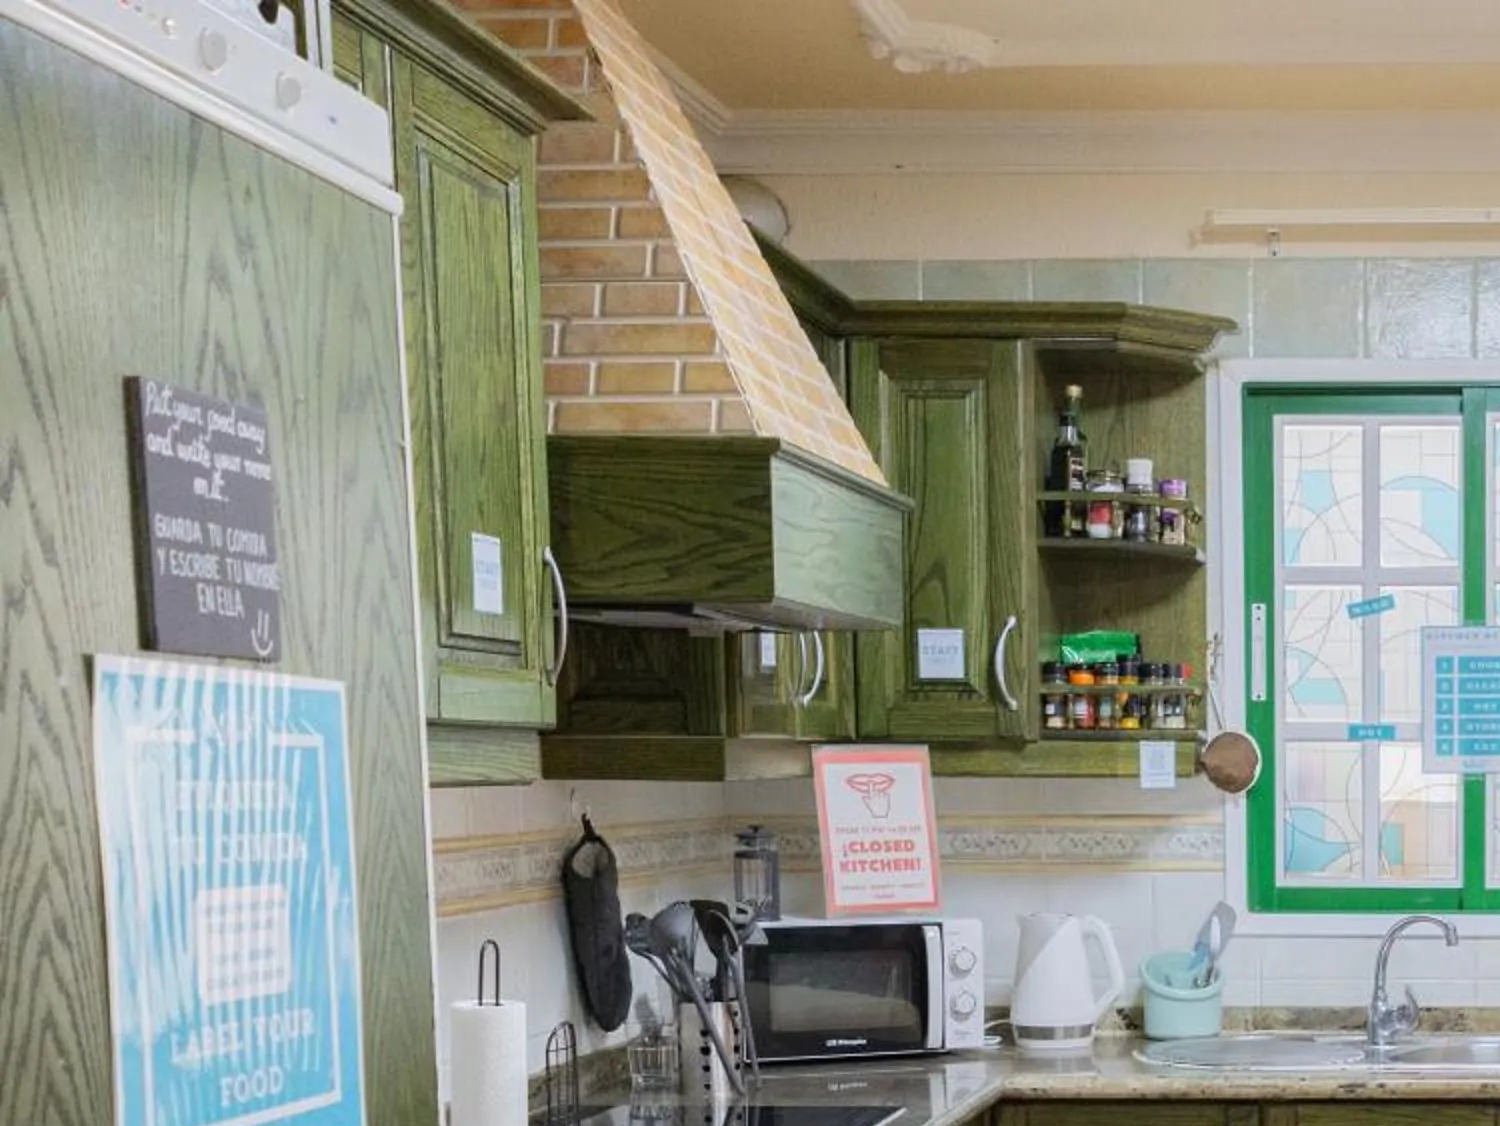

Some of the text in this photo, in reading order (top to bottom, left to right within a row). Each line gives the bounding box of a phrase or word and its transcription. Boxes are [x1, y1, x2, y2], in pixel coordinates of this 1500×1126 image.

[145, 381, 173, 416] Put
[205, 407, 236, 442] food
[237, 421, 265, 454] away
[146, 428, 174, 457] and
[154, 512, 267, 557] GUARDA TU COMIDA
[157, 547, 166, 577] Y
[169, 548, 220, 580] ESCRIBE
[224, 557, 243, 584] TU
[197, 582, 245, 620] EN ELLA
[839, 857, 921, 873] KITCHEN!
[170, 1007, 315, 1064] LABEL YOUR
[220, 1066, 285, 1108] FOOD
